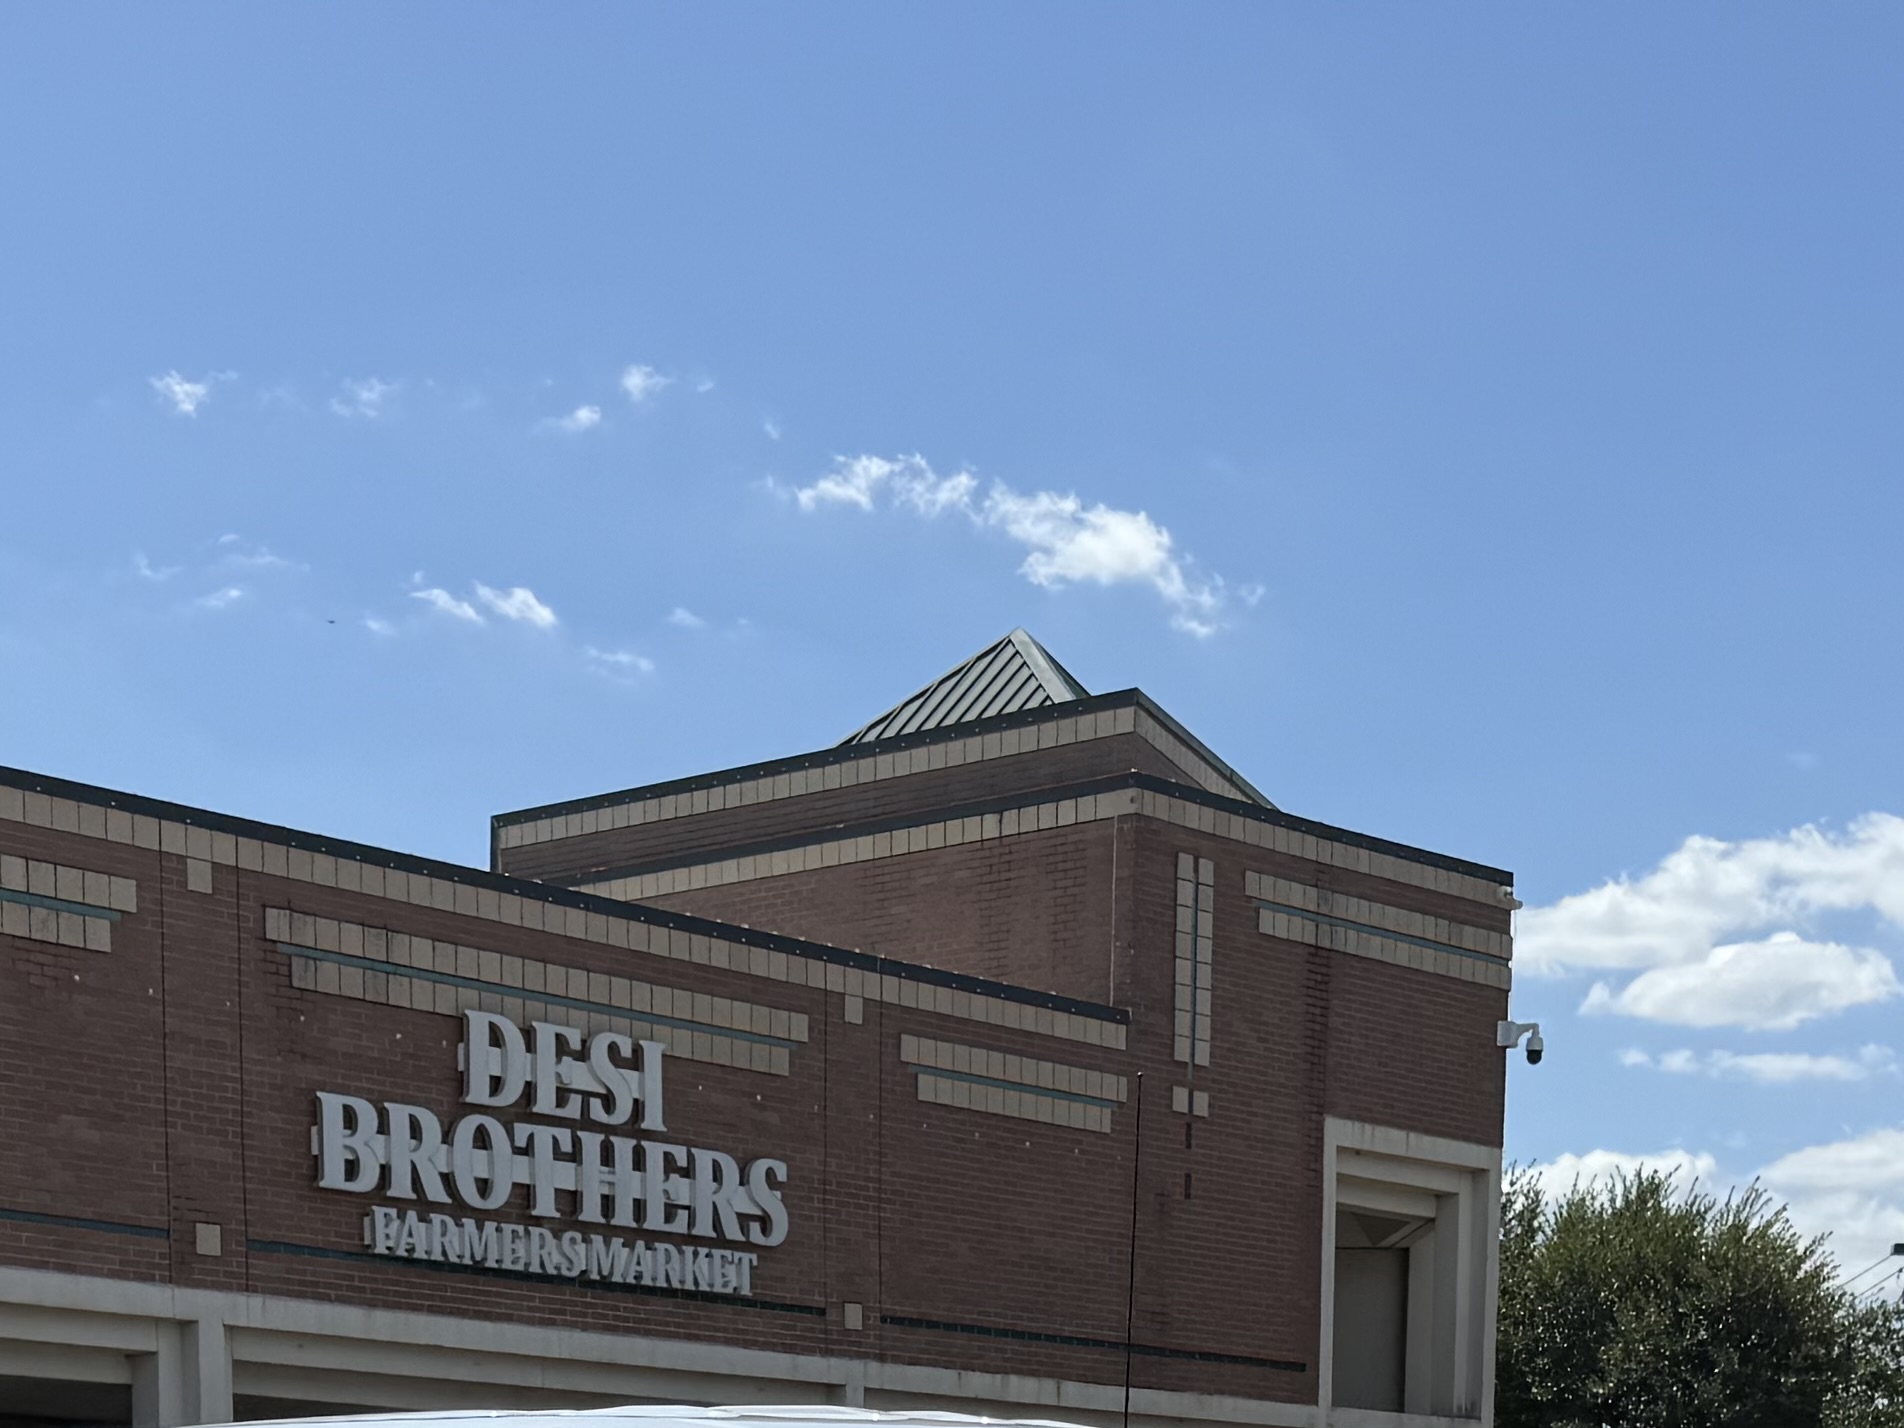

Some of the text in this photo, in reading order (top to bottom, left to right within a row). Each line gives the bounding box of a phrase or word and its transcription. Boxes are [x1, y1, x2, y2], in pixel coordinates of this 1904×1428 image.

[462, 1008, 669, 1132] DESI
[315, 1091, 790, 1248] BROTHERS
[367, 1205, 759, 1297] FARMERS MARKET
